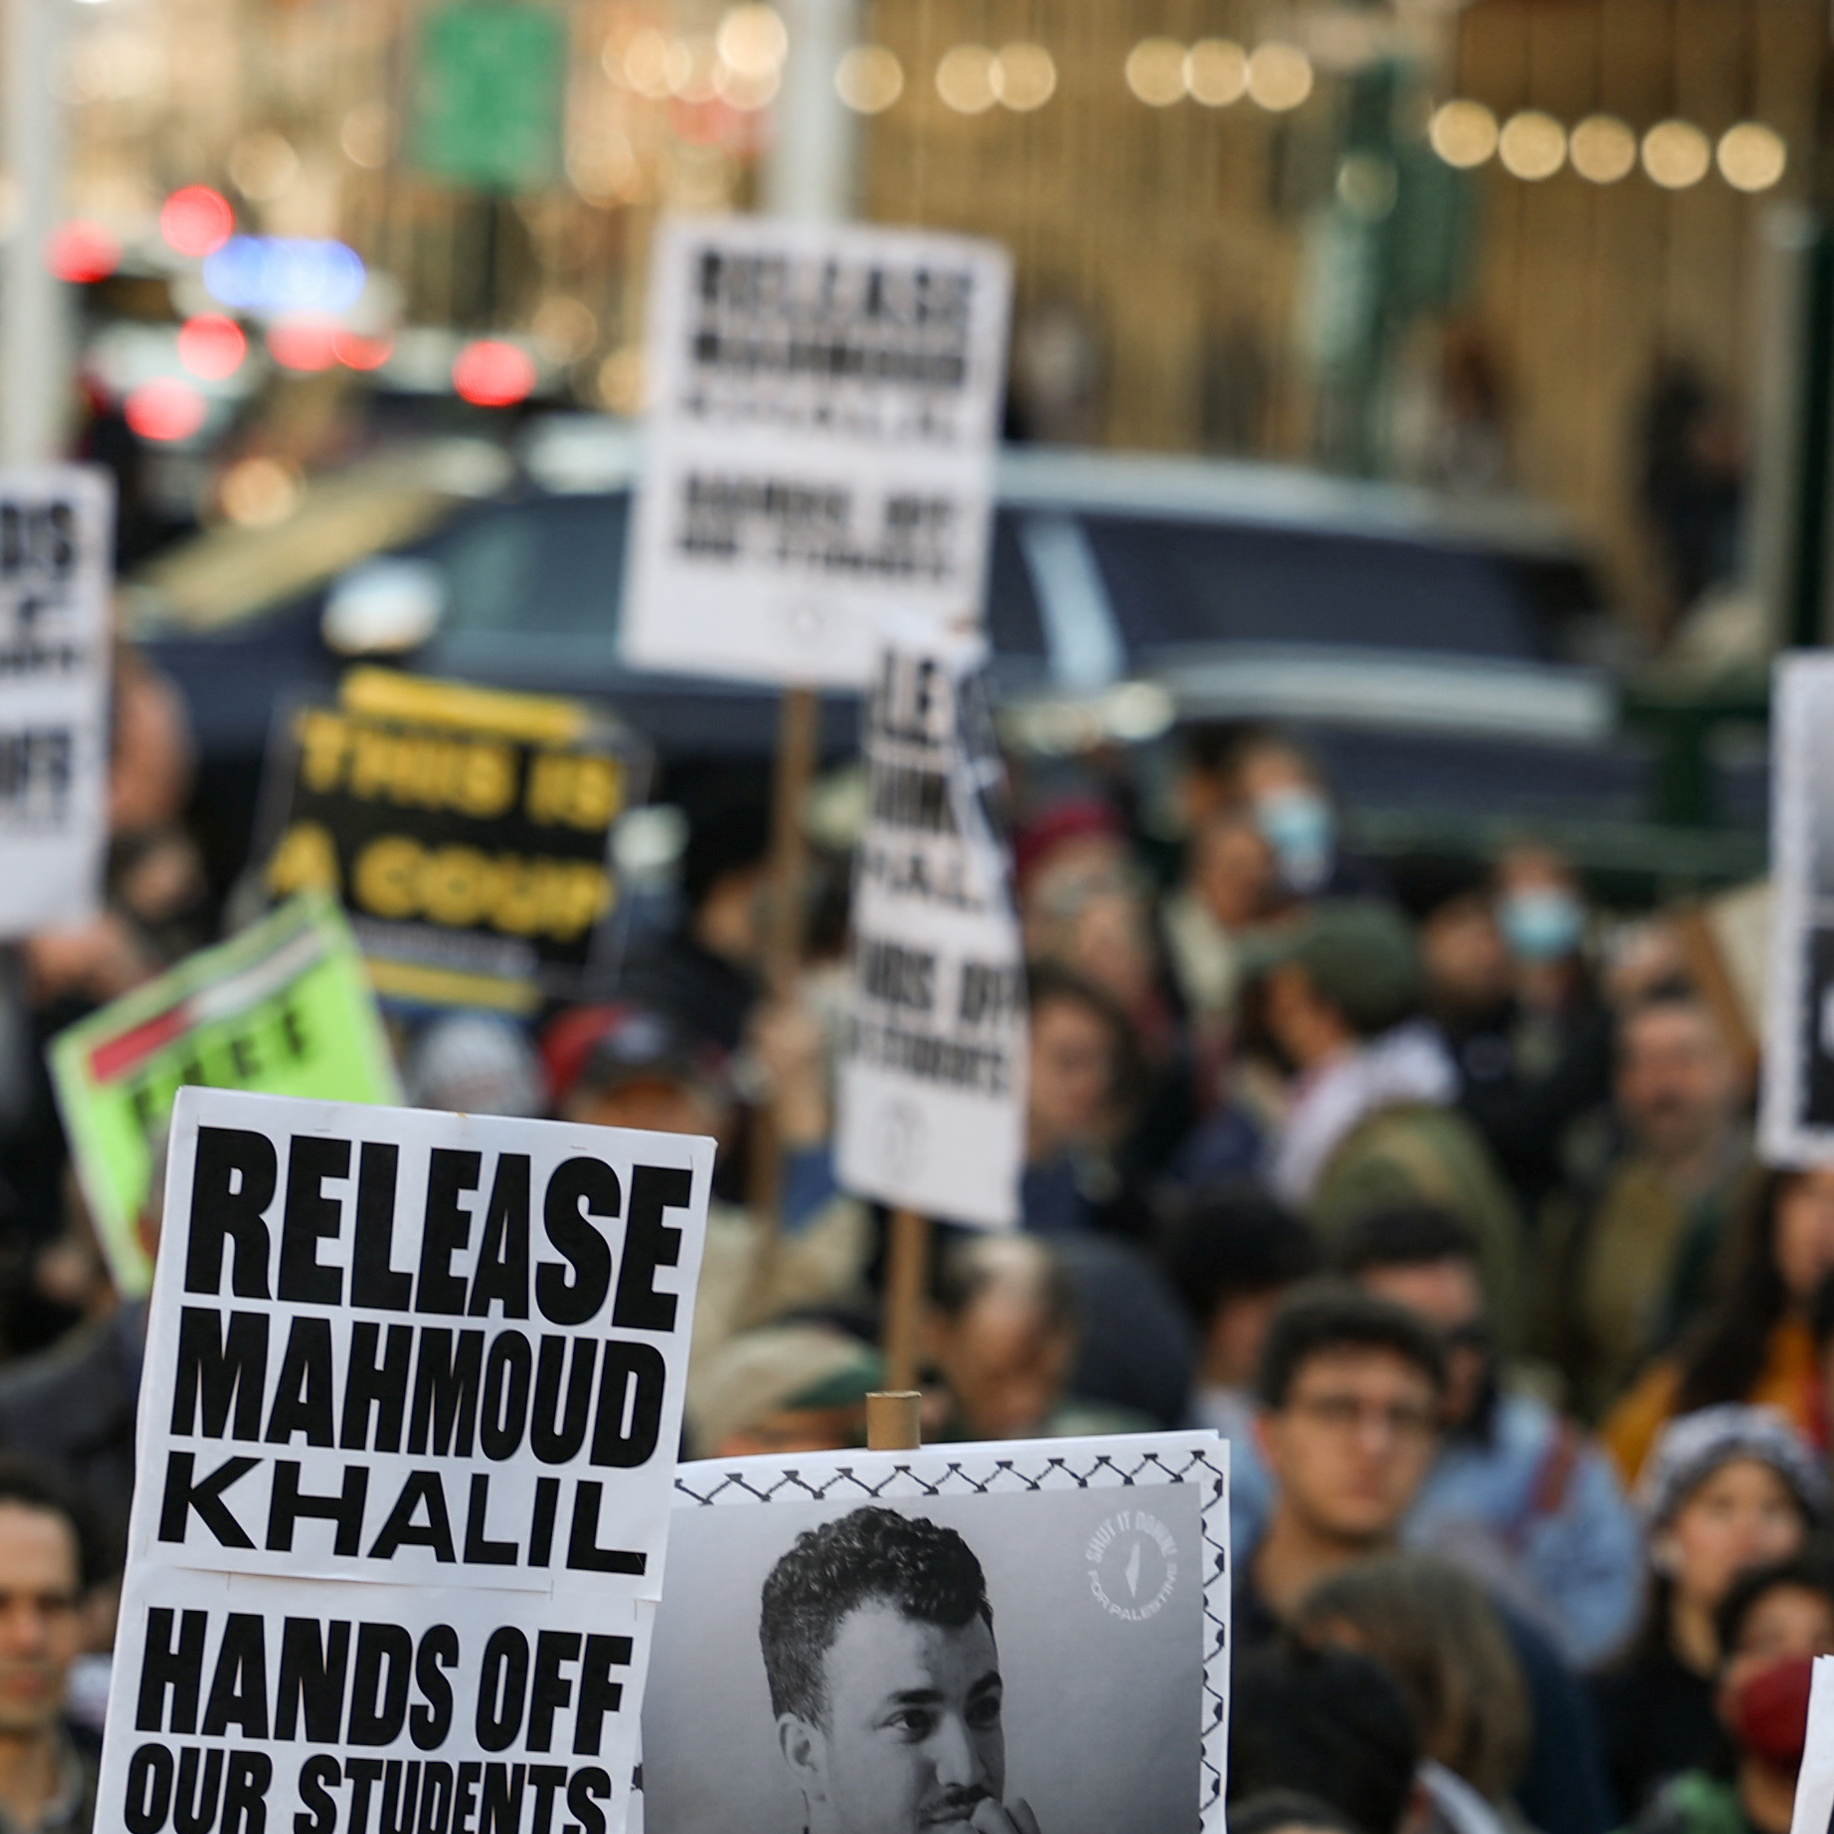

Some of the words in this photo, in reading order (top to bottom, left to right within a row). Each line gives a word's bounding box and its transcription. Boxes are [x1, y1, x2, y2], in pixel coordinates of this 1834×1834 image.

[294, 708, 518, 816] THIS
[523, 741, 626, 830] IS
[184, 1125, 693, 1332] RELEASE
[170, 1306, 666, 1469] MAHMOUD
[157, 1451, 648, 1577] KHALIL
[135, 1607, 460, 1751] HANDS
[475, 1626, 633, 1756] OFF
